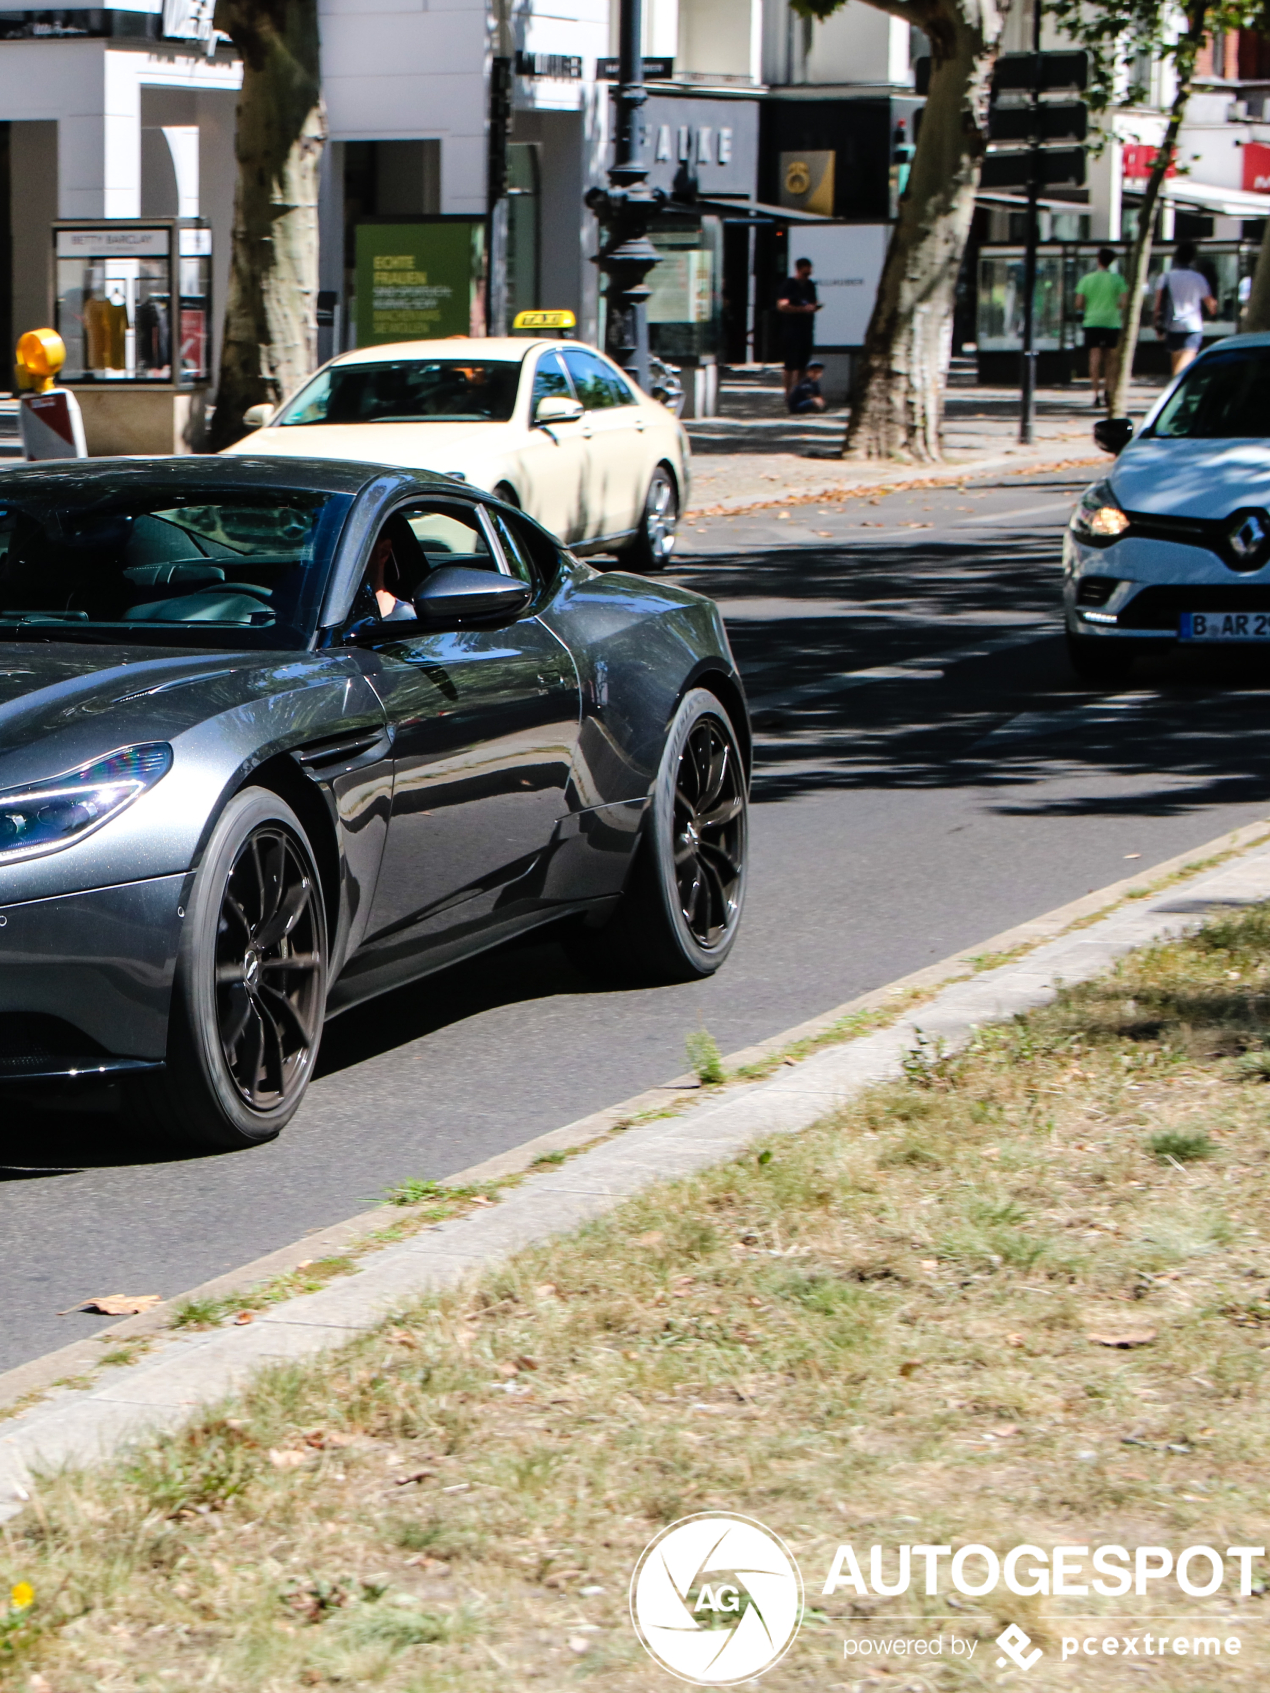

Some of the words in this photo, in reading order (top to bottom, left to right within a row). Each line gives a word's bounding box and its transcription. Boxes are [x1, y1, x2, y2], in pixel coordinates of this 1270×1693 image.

[373, 256, 415, 270] ECHTE
[373, 272, 428, 285] FRAUEN
[522, 313, 563, 326] TAXI
[1193, 615, 1207, 635] B
[1223, 615, 1249, 635] AR
[1254, 615, 1270, 635] 2
